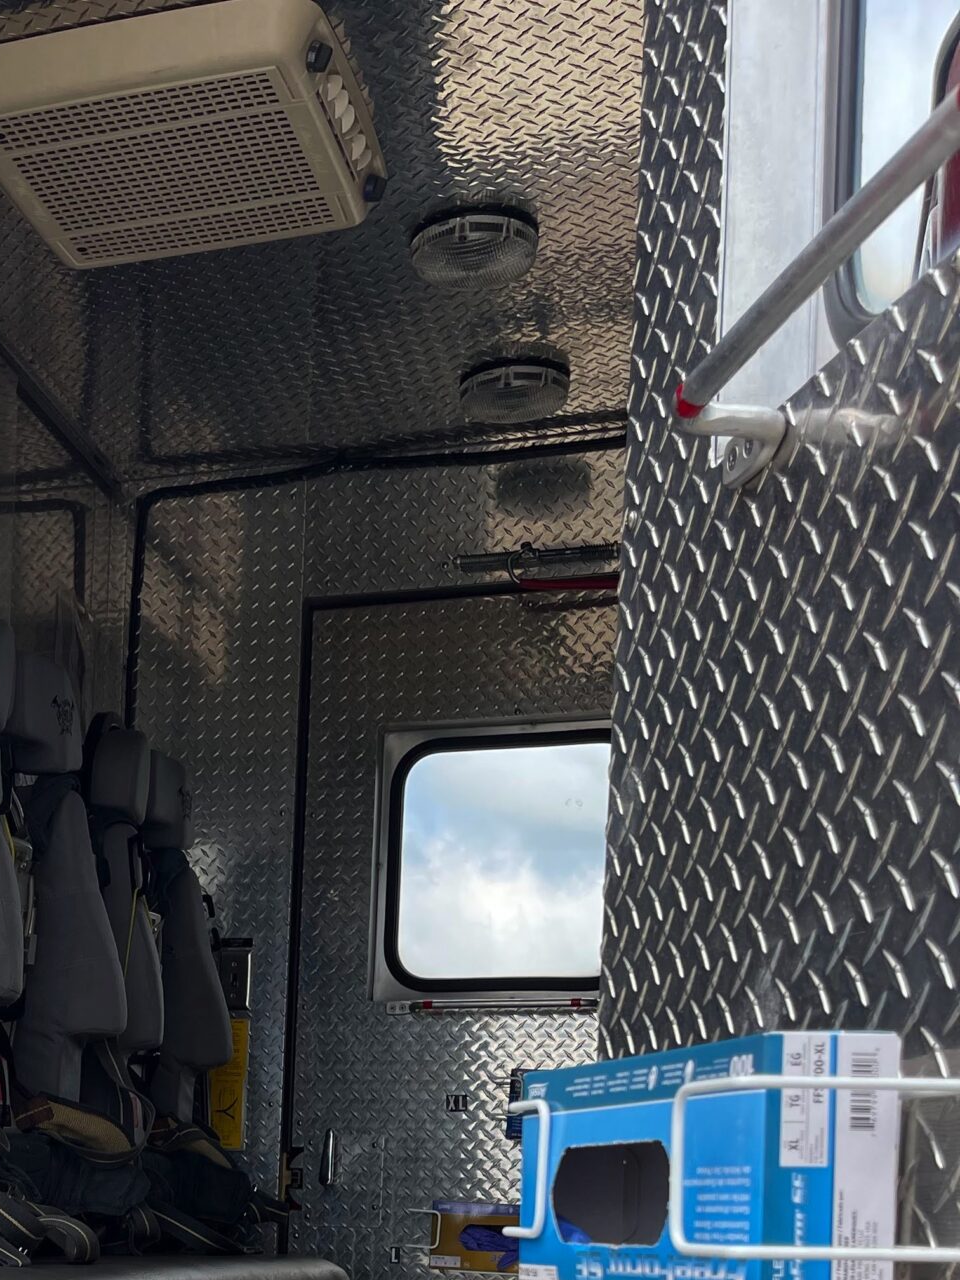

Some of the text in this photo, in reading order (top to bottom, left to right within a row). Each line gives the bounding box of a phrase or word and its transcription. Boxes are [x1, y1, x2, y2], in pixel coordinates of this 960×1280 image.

[813, 1041, 825, 1105] FFS00-XL
[447, 1095, 466, 1110] XL
[788, 1052, 802, 1151] XL TG EG
[391, 1247, 399, 1263] L
